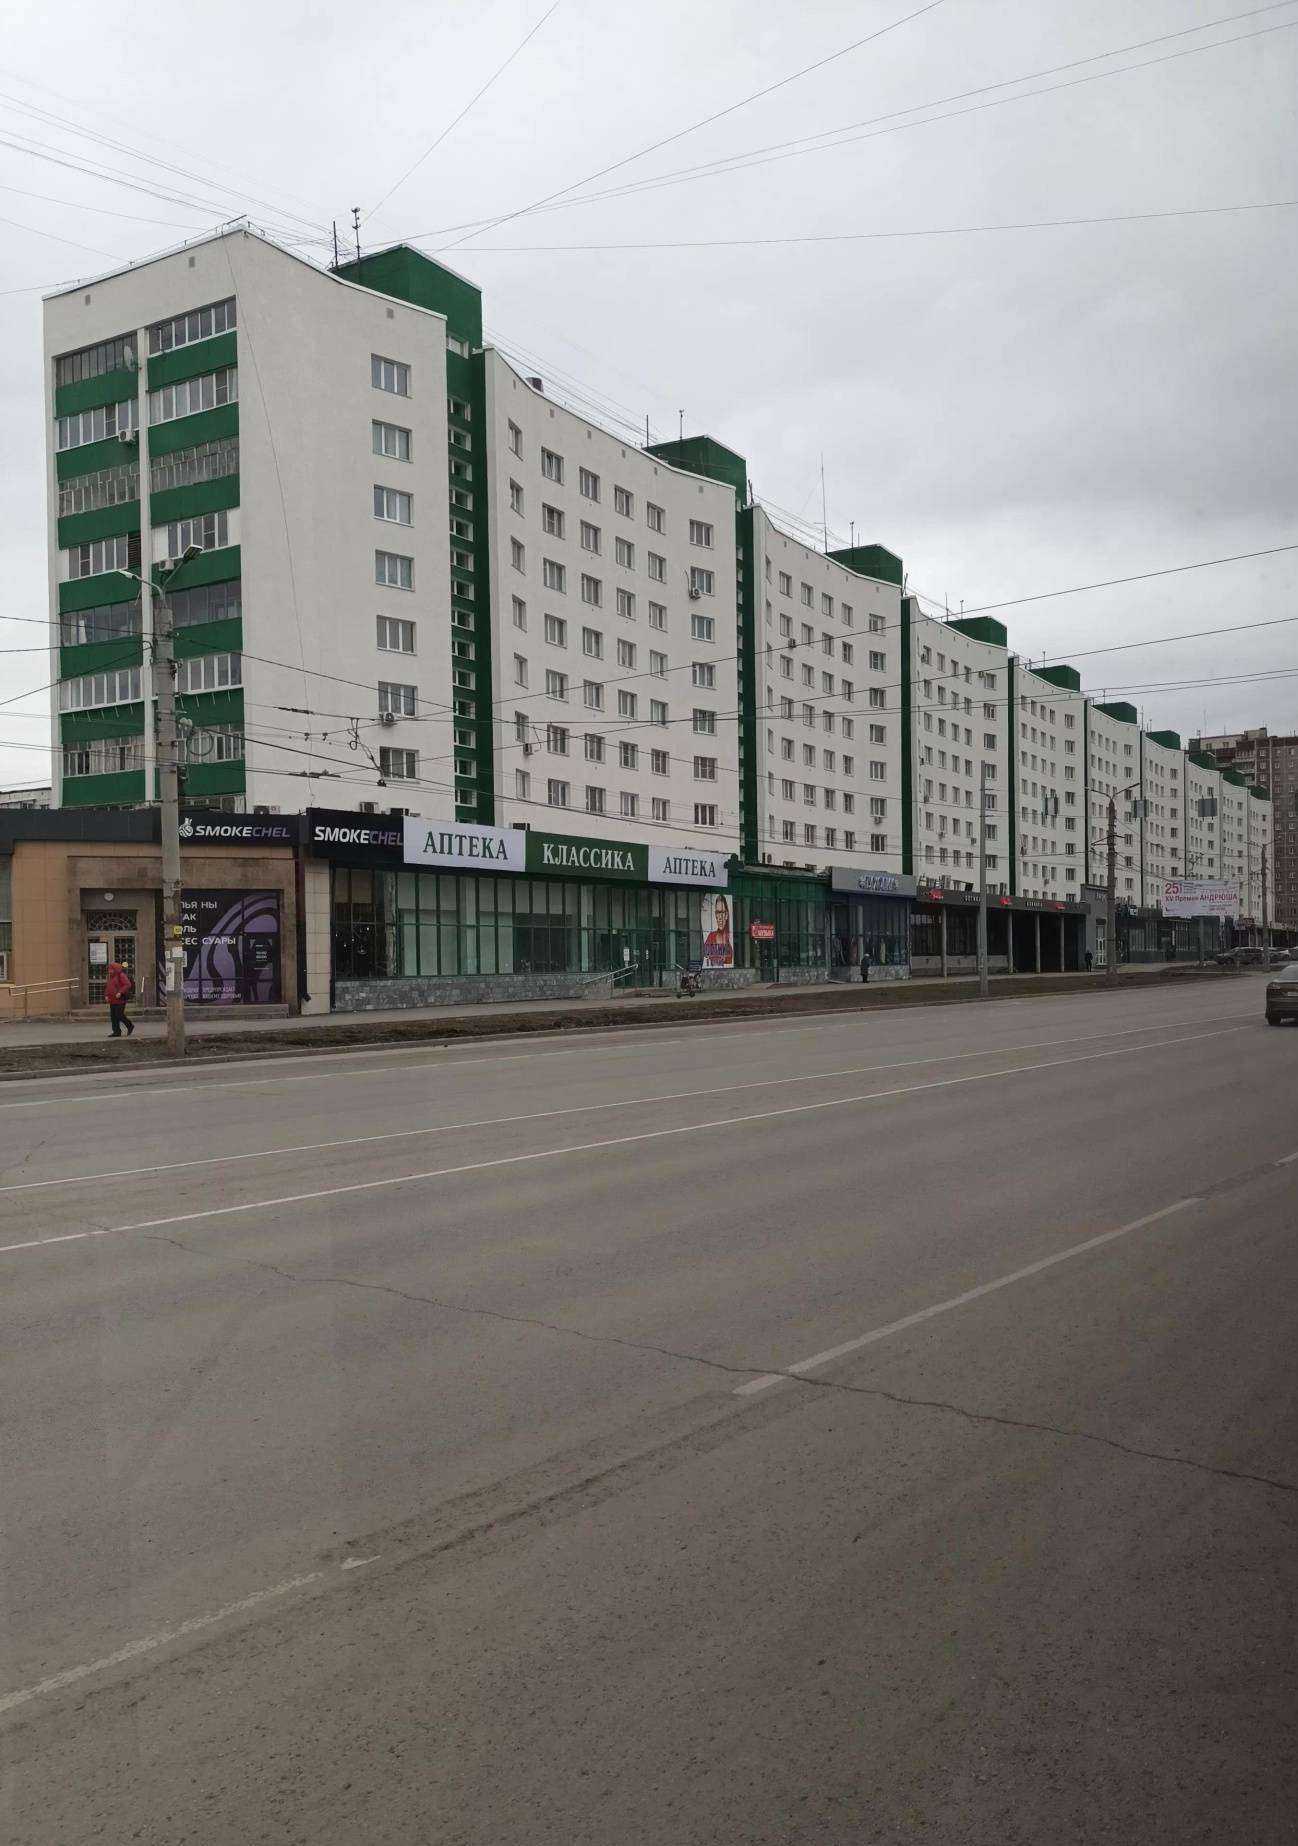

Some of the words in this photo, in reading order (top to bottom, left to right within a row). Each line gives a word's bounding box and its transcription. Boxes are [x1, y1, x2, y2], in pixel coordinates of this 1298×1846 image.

[195, 825, 290, 838] SMOKECHEL
[313, 826, 403, 846] SMOKECHEL
[422, 830, 508, 861] АПТЕКА
[542, 842, 635, 871] КЛАССИКА
[661, 856, 716, 878] АПТЕКА
[201, 901, 217, 909] НЫ
[1199, 893, 1238, 902] АНДРЮША
[202, 937, 236, 945] СУАРЫ
